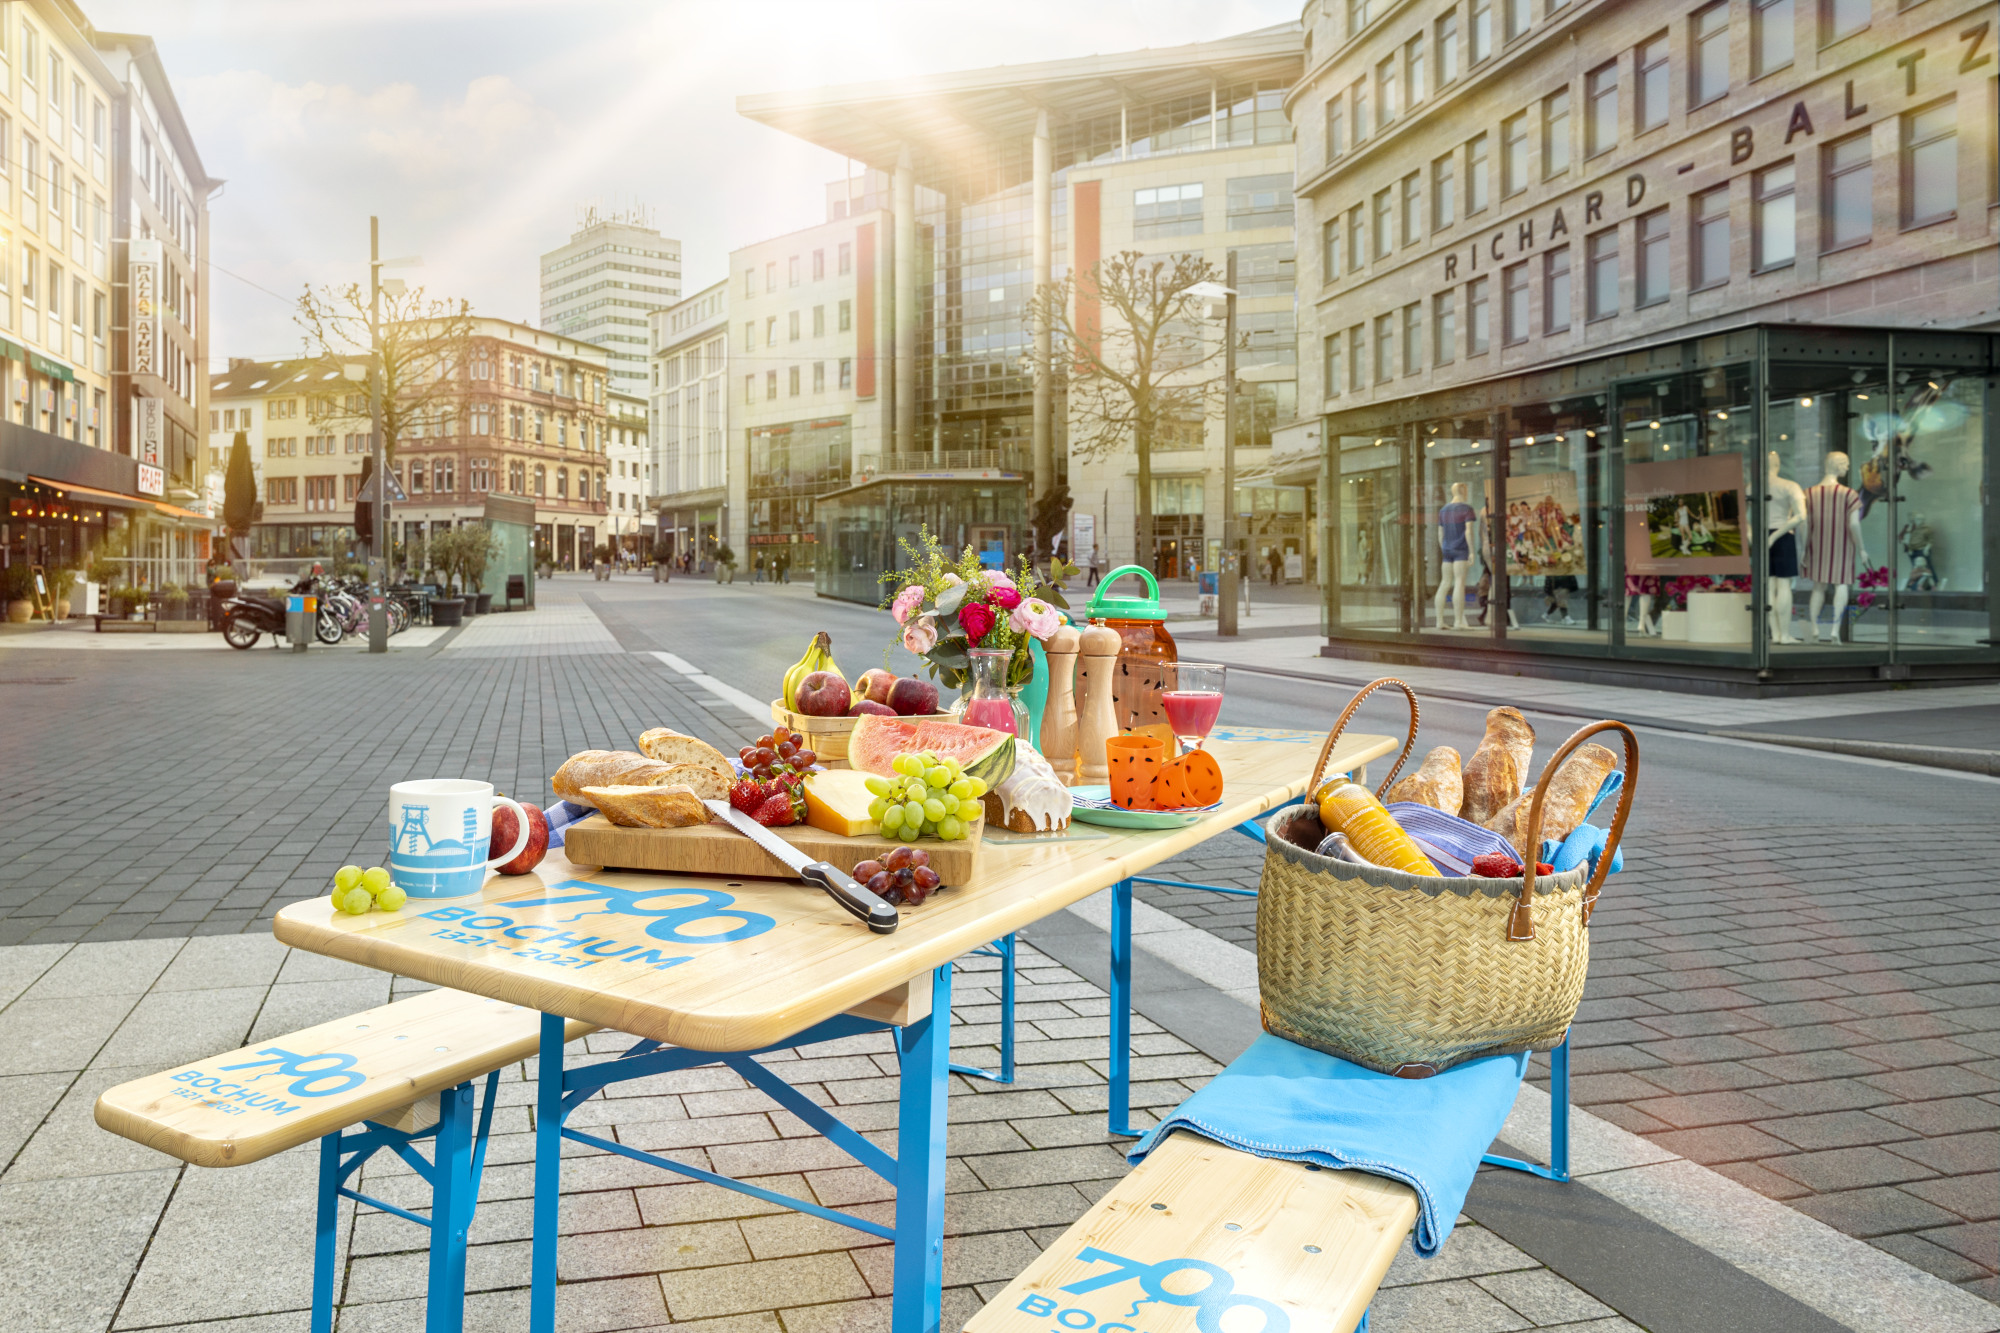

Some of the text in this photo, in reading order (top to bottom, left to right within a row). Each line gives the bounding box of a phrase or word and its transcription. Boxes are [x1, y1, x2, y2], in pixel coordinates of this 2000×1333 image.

[137, 265, 151, 373] PALLAS ATHENA
[141, 466, 161, 493] PFAFF
[493, 880, 776, 944] 700
[416, 907, 696, 970] BOCHUM
[430, 929, 498, 947] 1321
[511, 948, 598, 970] 2021
[170, 1070, 302, 1116] BOCHUM
[217, 1047, 367, 1098] 700
[169, 1087, 202, 1102] 1321
[209, 1100, 248, 1116] 2021
